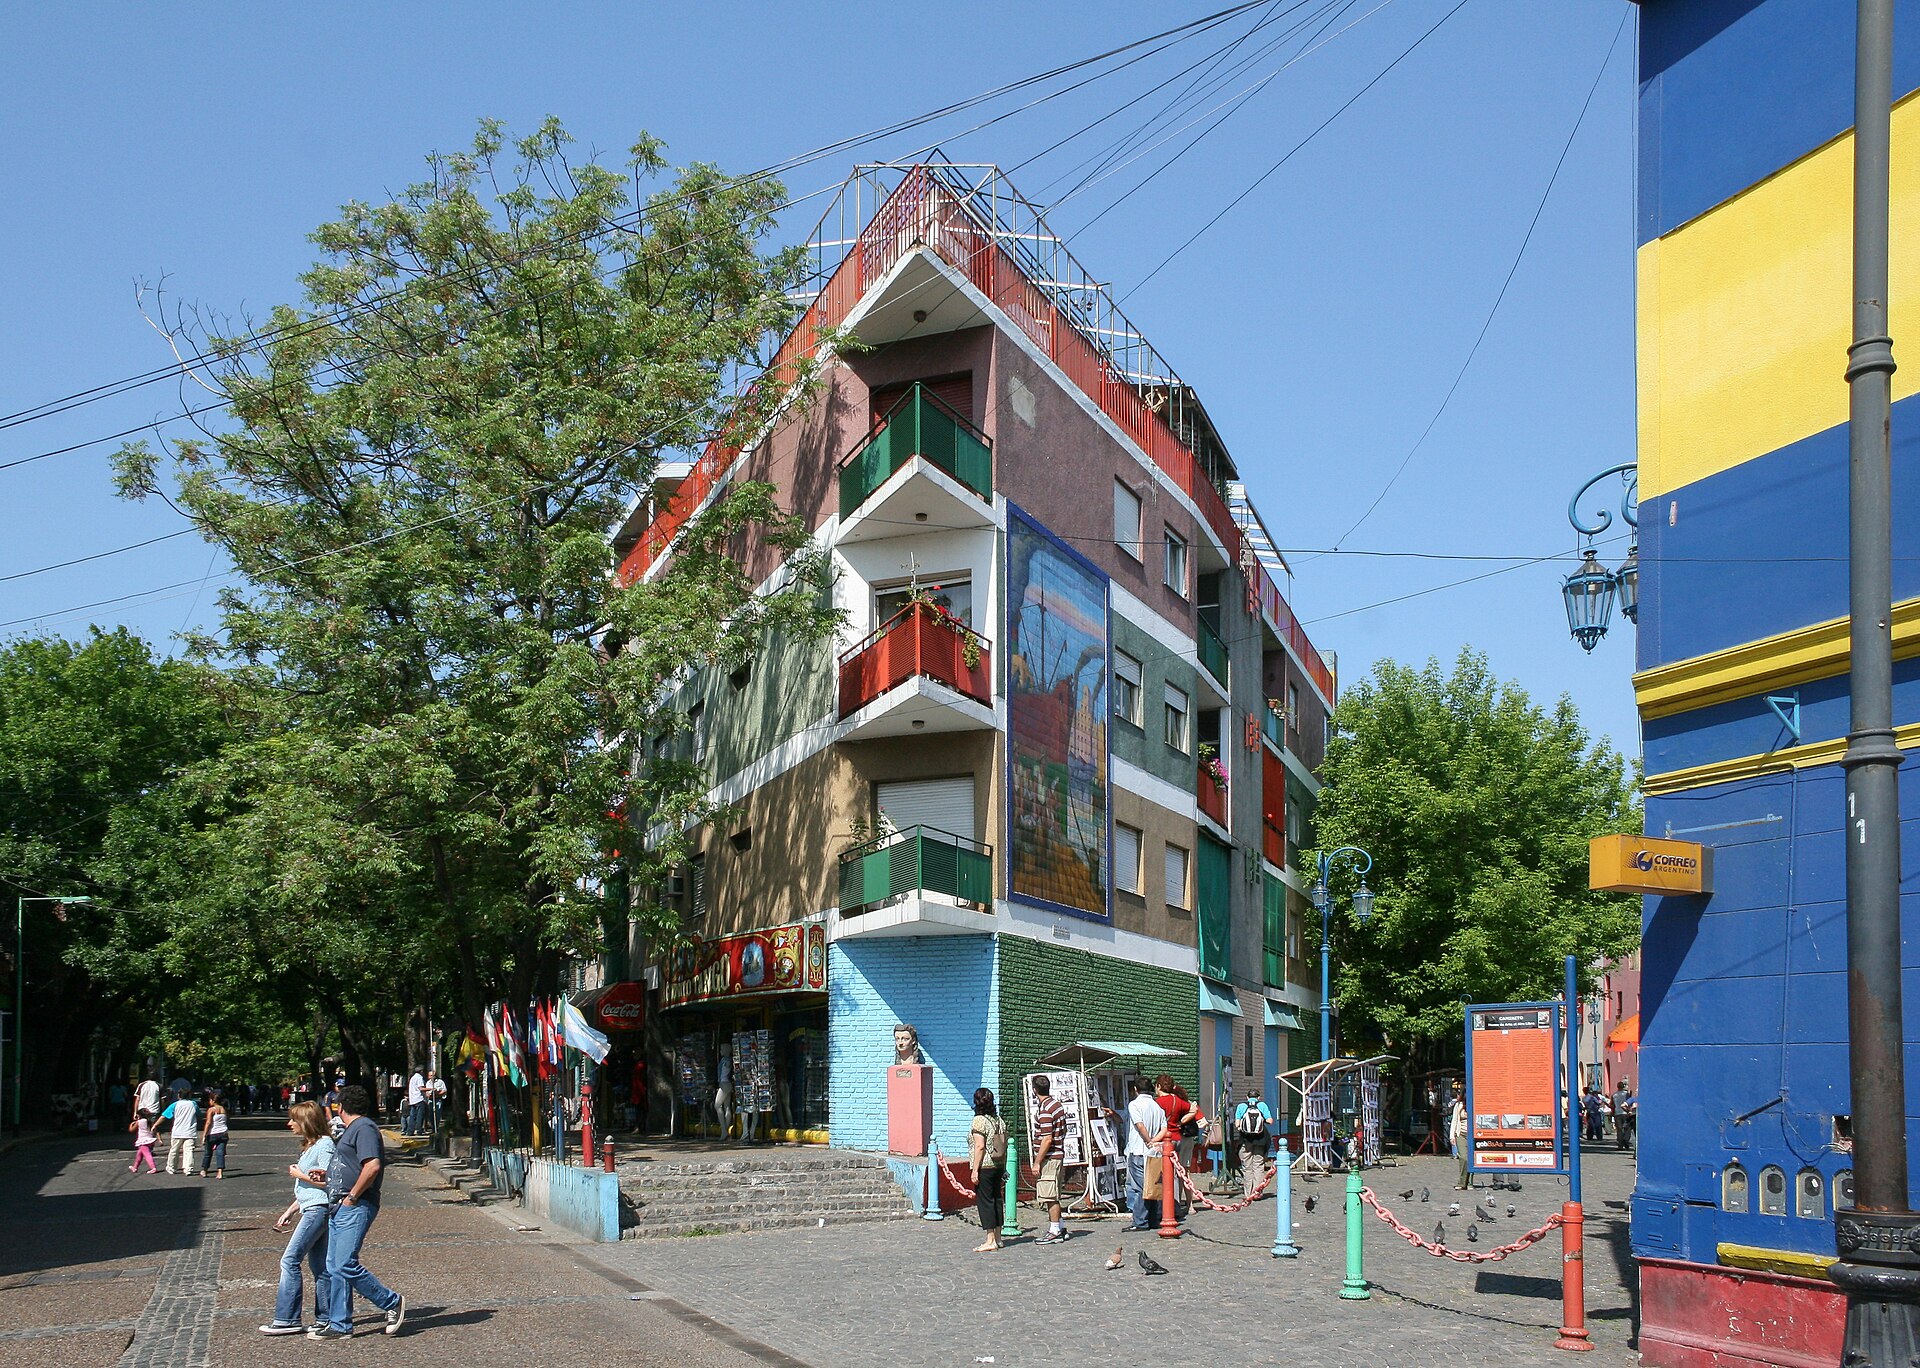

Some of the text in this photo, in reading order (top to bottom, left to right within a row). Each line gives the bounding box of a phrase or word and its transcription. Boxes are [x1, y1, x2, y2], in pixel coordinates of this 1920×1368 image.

[1856, 818, 1865, 844] 1
[1653, 853, 1697, 869] CORREO
[1653, 866, 1695, 875] ARGENTINO
